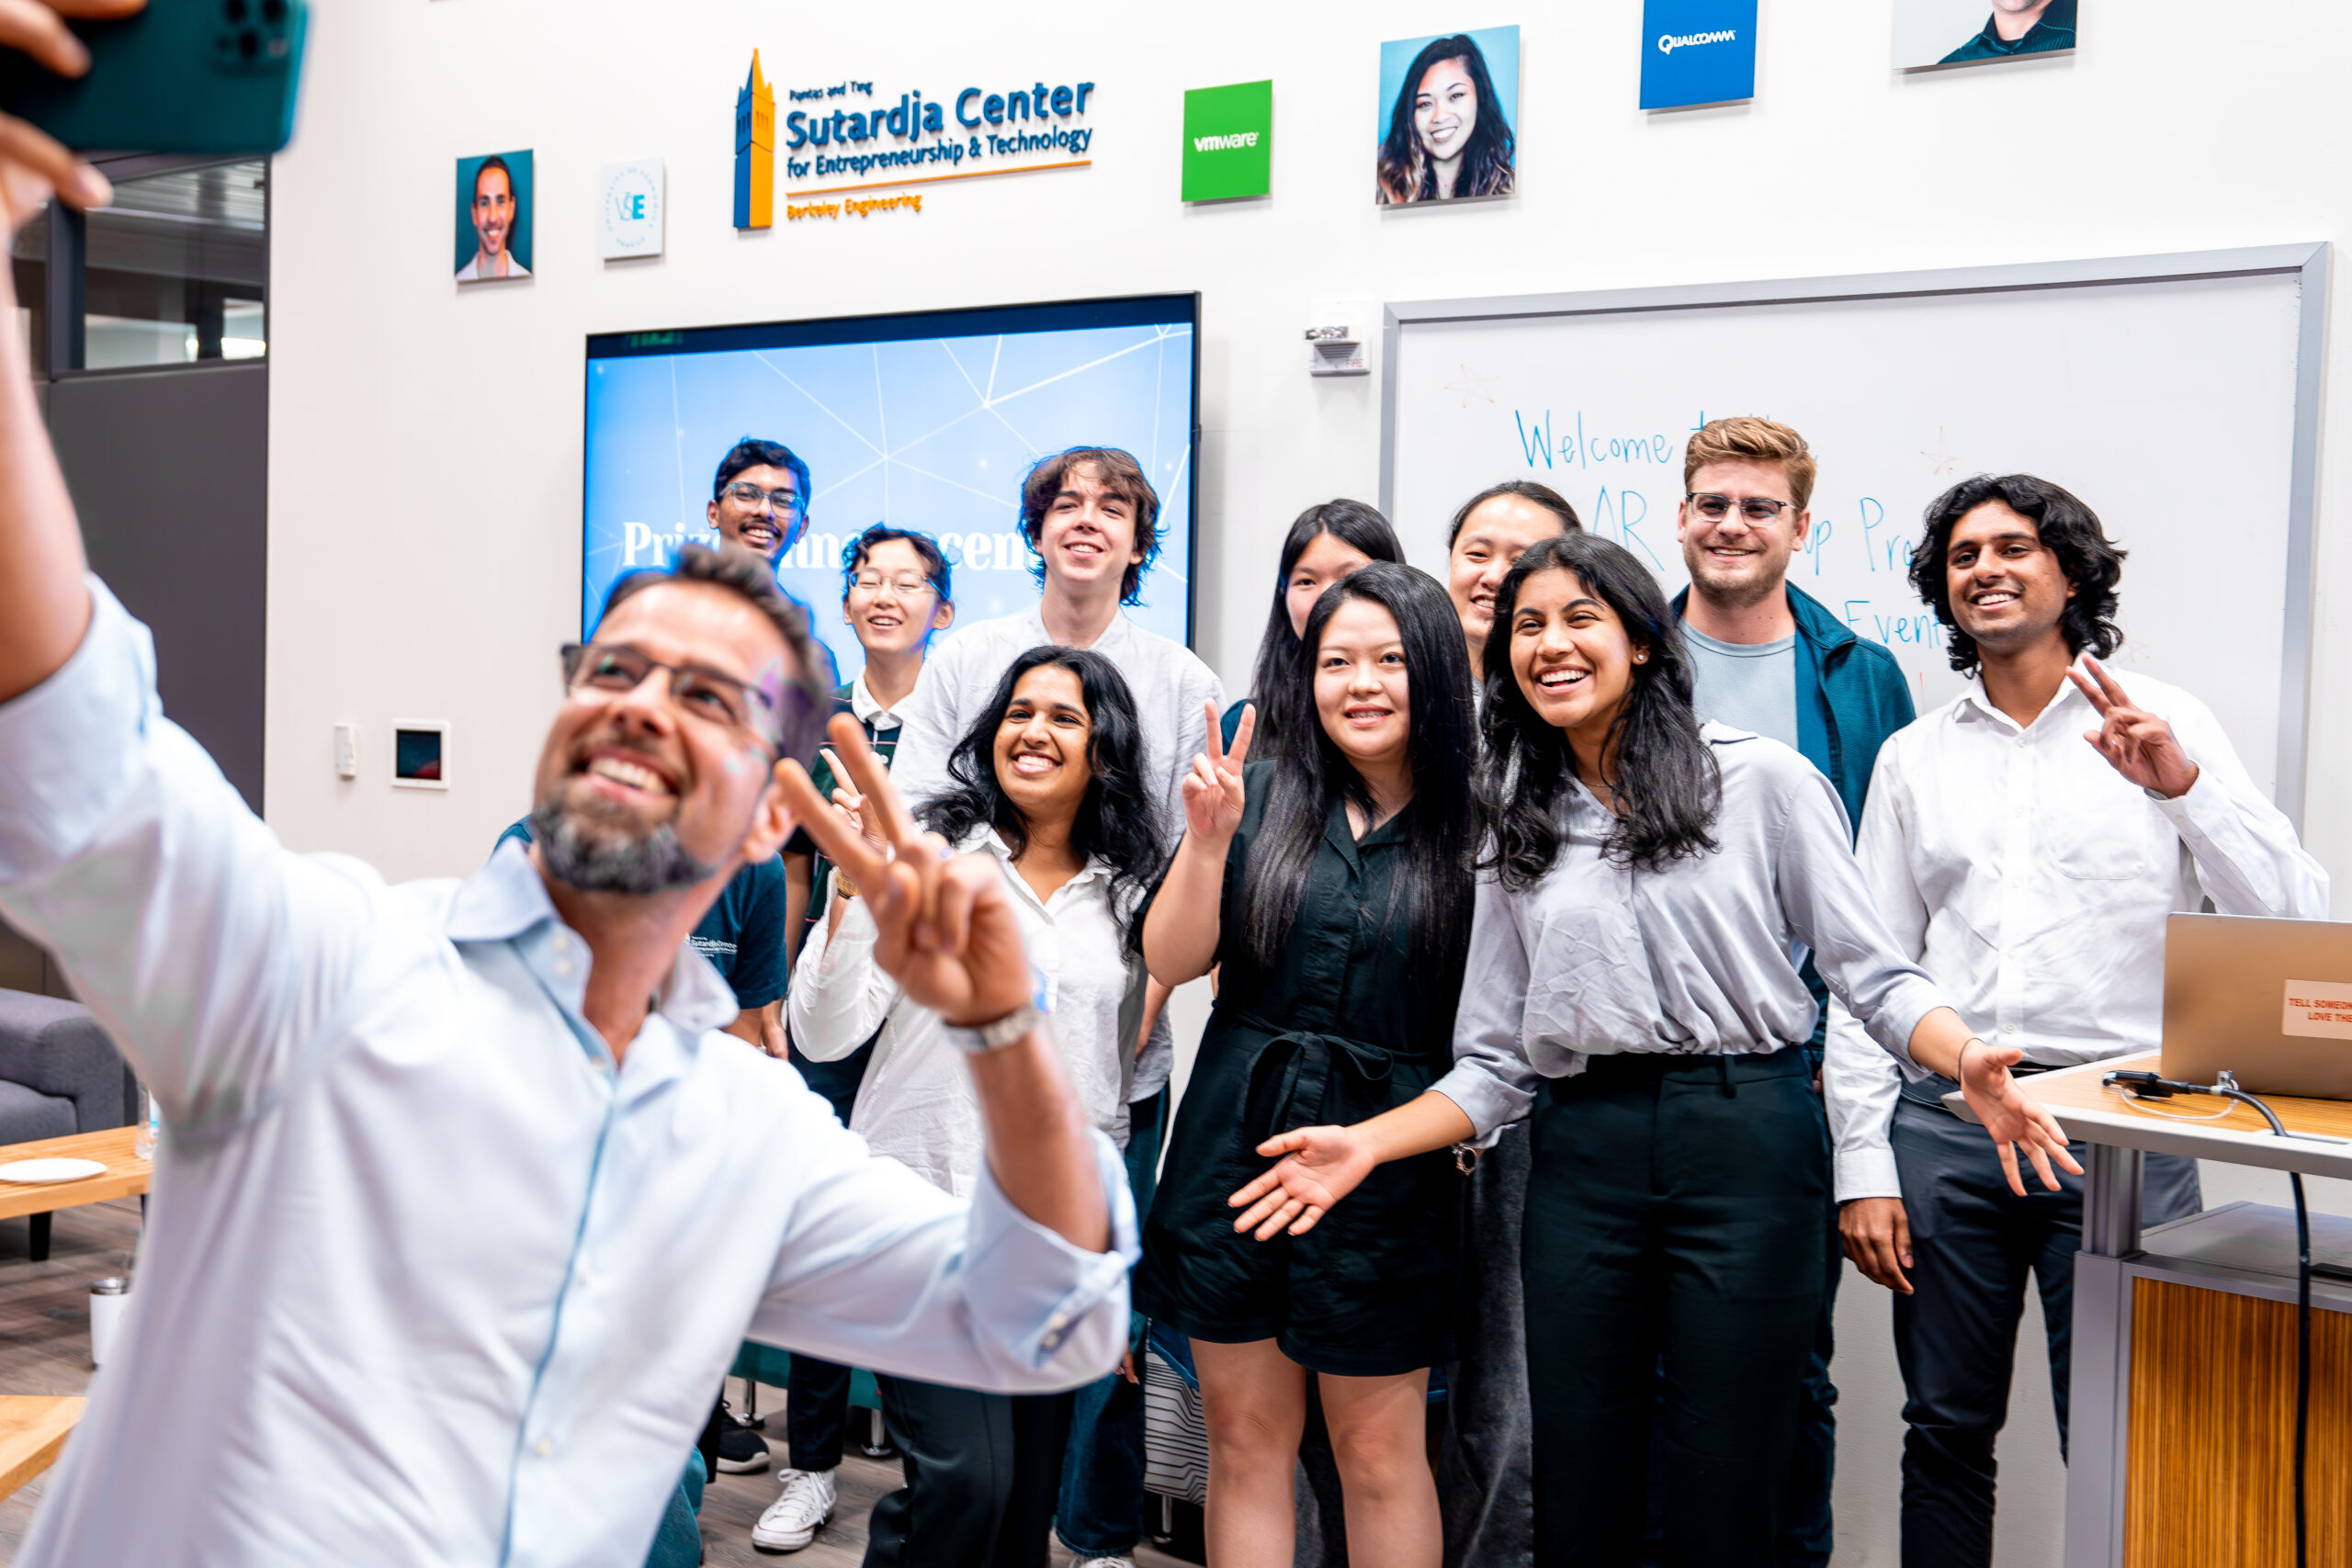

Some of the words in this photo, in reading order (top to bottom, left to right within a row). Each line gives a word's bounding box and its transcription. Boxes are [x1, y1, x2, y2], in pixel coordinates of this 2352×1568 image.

[827, 81, 846, 97] and
[786, 90, 944, 148] Sutardja
[956, 82, 1094, 127] Center
[787, 156, 810, 177] for
[816, 139, 963, 176] Entrepreneurship
[969, 136, 981, 158] &
[987, 125, 1092, 155] Technology
[1194, 132, 1259, 152] vmware
[787, 199, 840, 220] Berkeley
[845, 191, 922, 217] Engineering
[1515, 410, 1673, 469] Welcome
[2289, 998, 2311, 1007] TELL
[2308, 1011, 2333, 1021] LOVE
